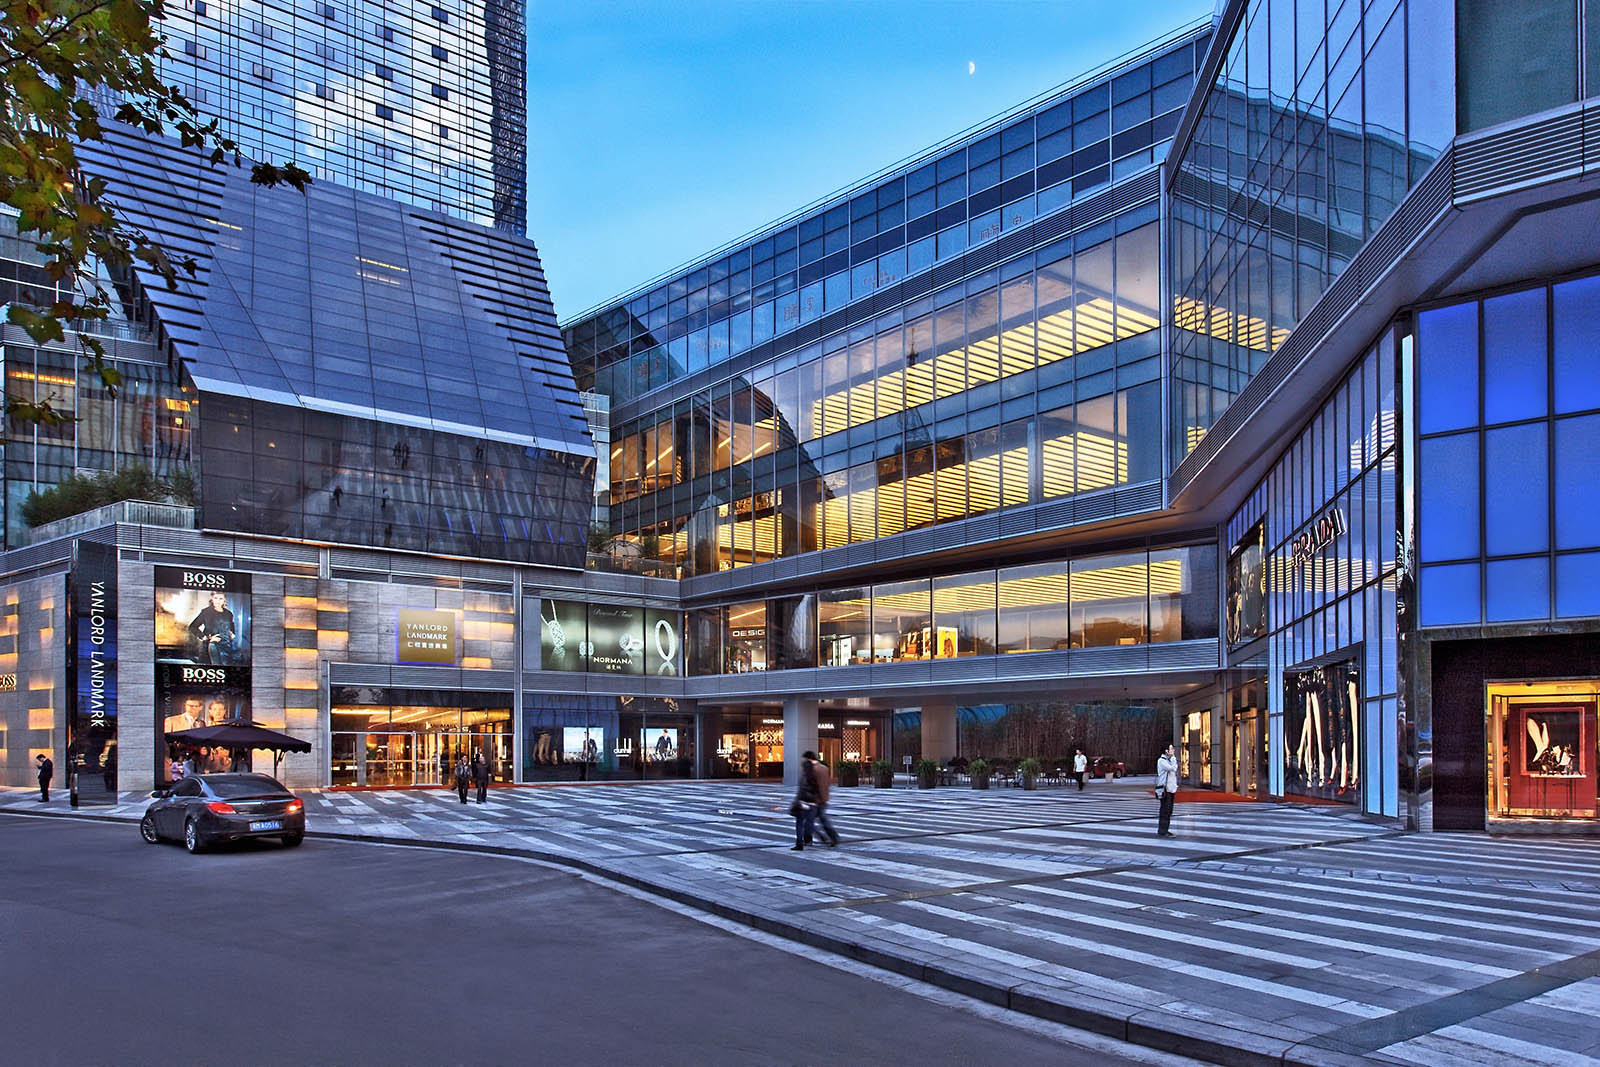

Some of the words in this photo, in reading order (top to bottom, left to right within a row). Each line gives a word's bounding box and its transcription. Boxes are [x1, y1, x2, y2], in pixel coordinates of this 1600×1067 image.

[183, 571, 226, 585] BOSS
[90, 581, 105, 645] YANLORD
[406, 623, 448, 632] YANLORD
[406, 631, 448, 641] LANDMARK
[593, 656, 633, 665] NORMANA
[183, 667, 226, 680] BOSS
[90, 651, 105, 728] LANDMARK
